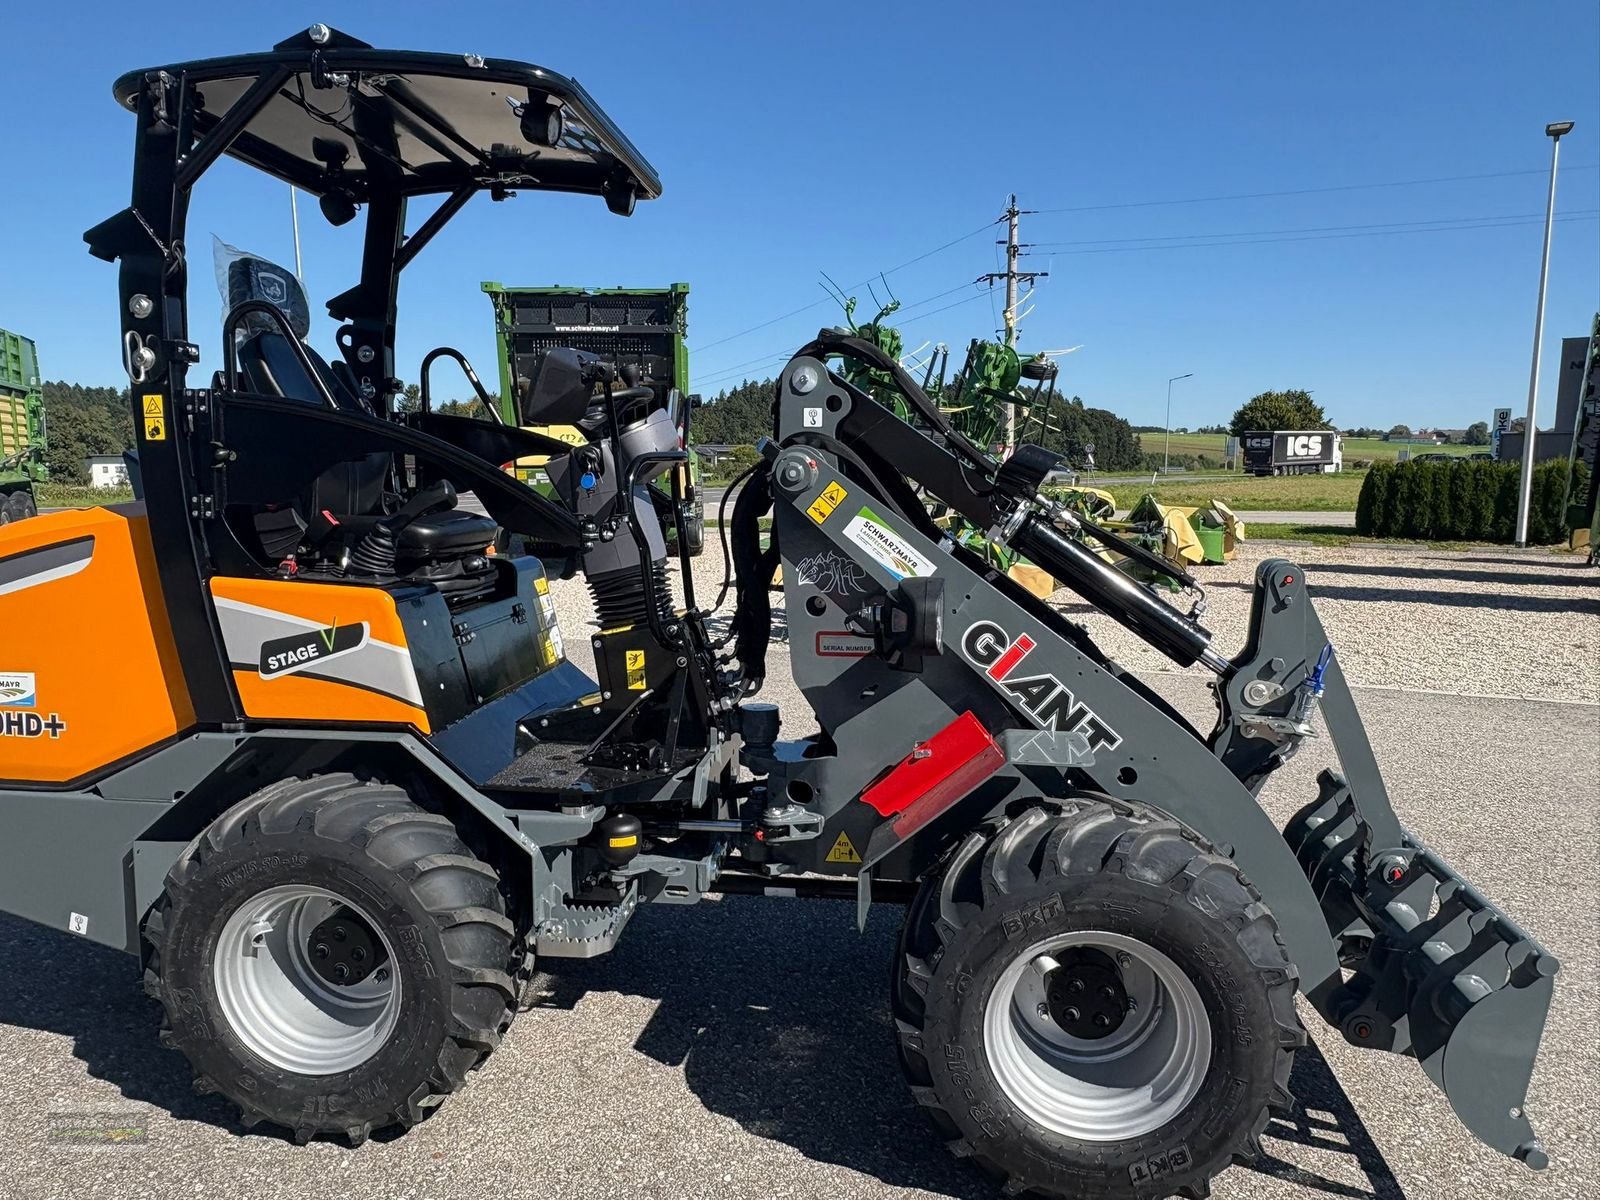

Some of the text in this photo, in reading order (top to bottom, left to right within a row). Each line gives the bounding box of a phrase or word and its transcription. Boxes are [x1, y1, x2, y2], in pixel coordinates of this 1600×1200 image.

[1246, 438, 1271, 447] ICS
[1287, 436, 1322, 456] ICS
[863, 521, 918, 569] SCHWARZMAYR
[267, 643, 319, 670] STAGE
[1003, 894, 1065, 938] BKT
[1130, 1147, 1190, 1184] BKT
